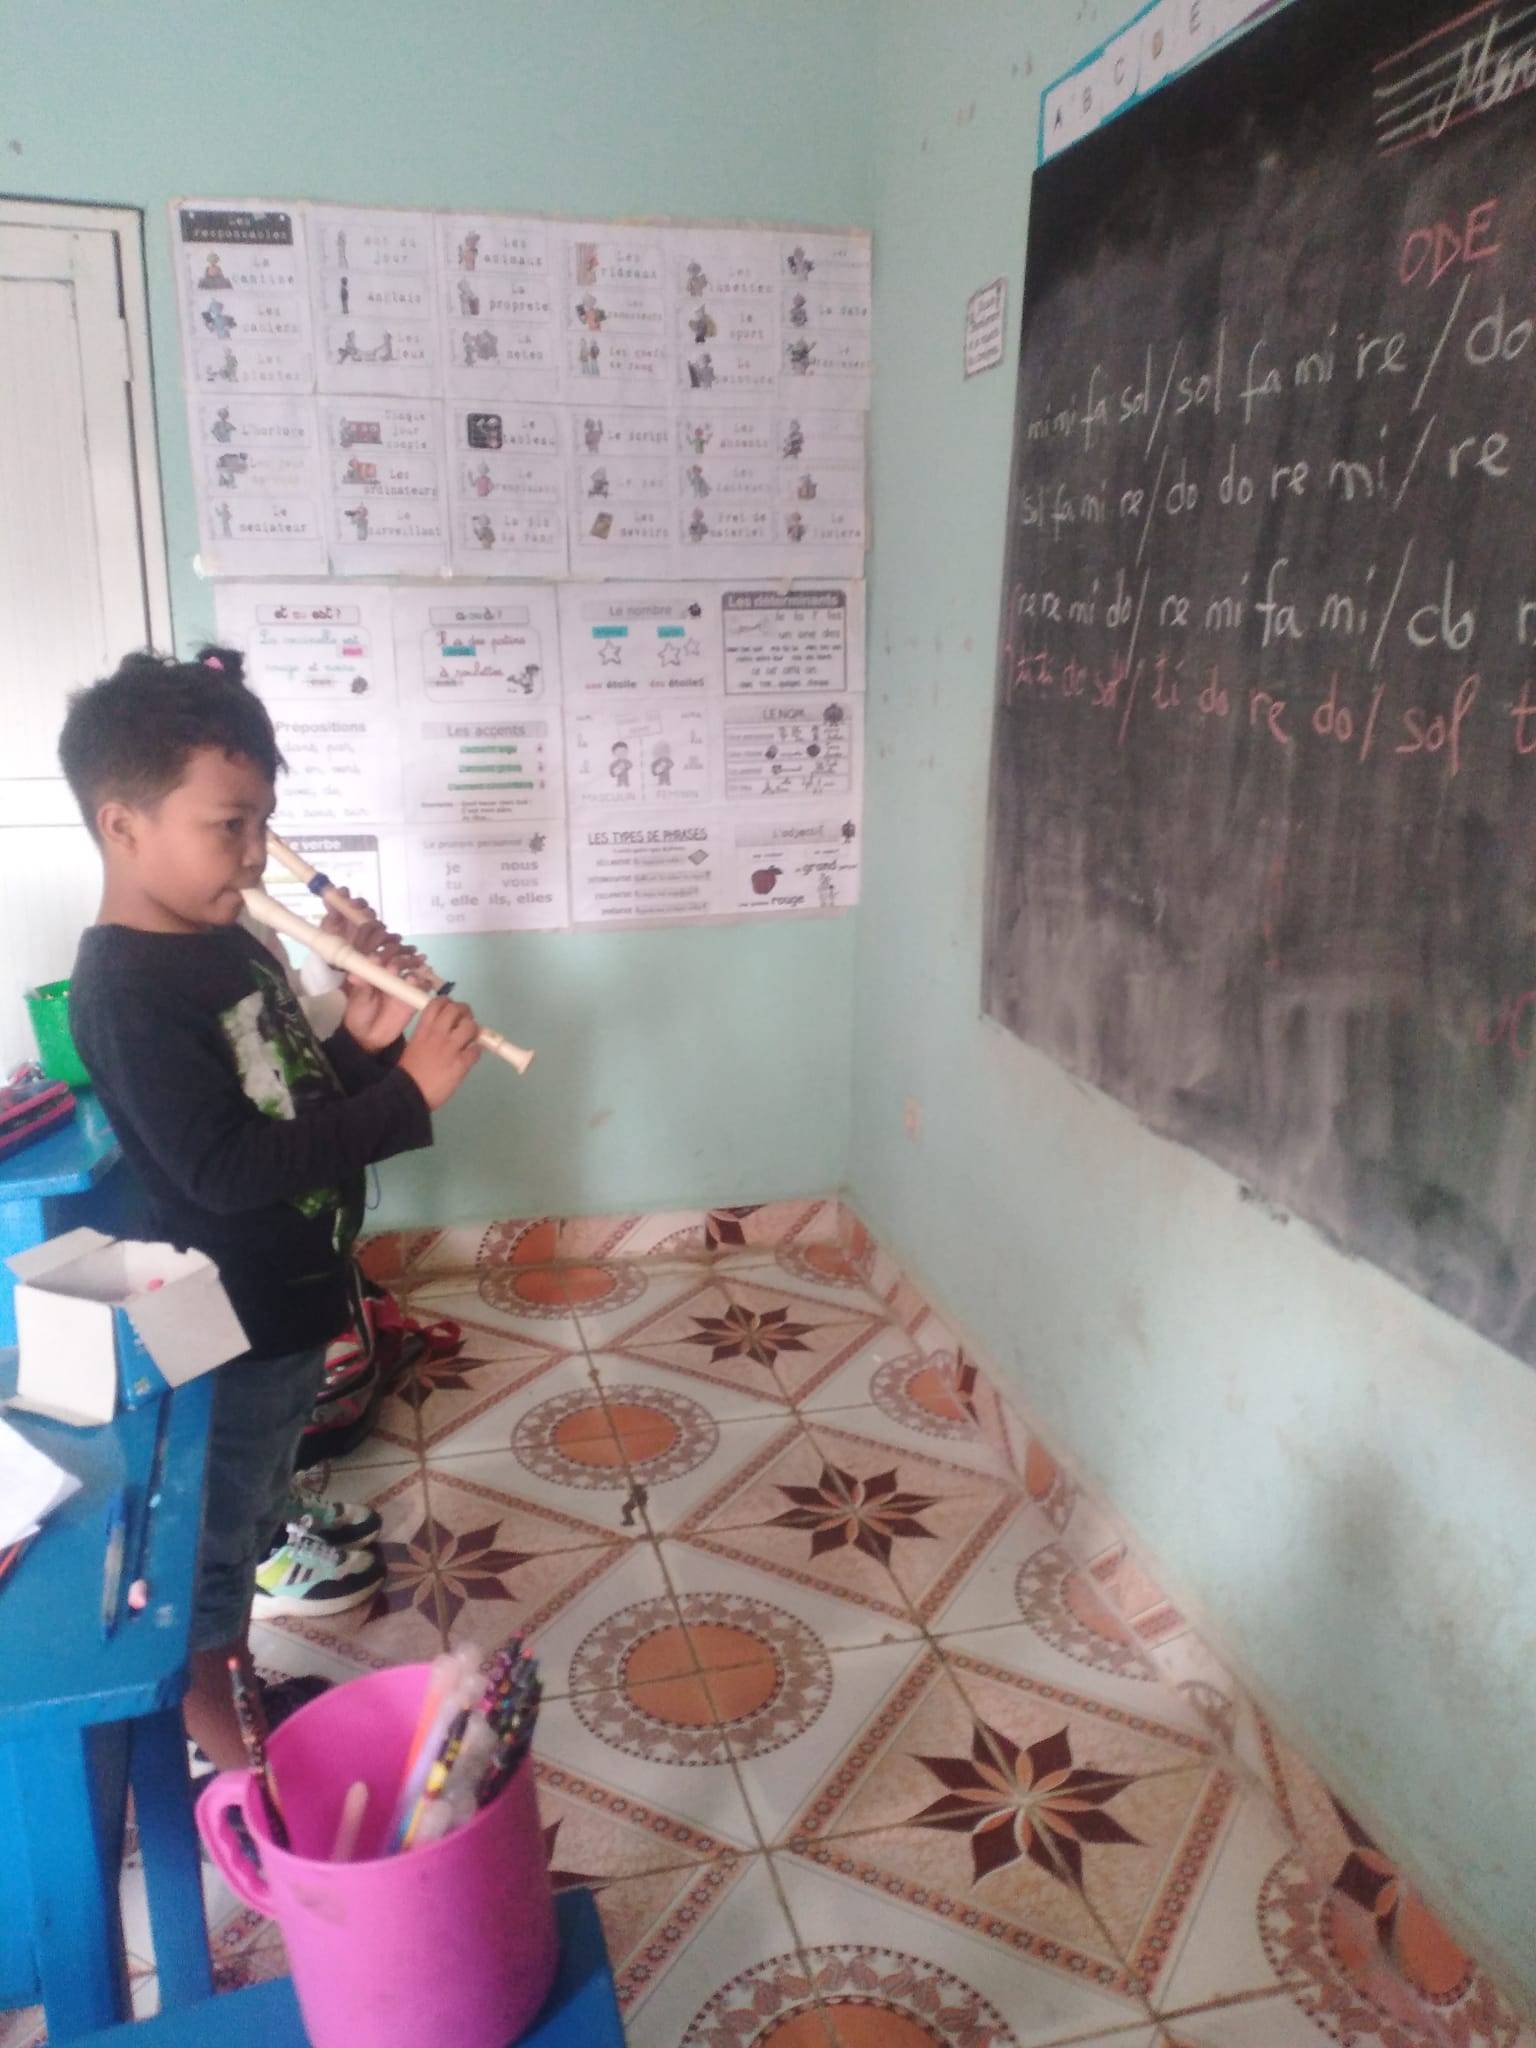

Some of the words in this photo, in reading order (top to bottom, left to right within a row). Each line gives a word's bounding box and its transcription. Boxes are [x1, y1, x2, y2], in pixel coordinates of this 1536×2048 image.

[1402, 197, 1500, 289] ODE
[1239, 337, 1282, 425] fa
[1355, 331, 1407, 382] re
[1464, 293, 1536, 366] do
[1219, 442, 1254, 505] do
[1448, 431, 1511, 480] re
[1255, 558, 1304, 648] fa
[1311, 671, 1355, 743] do
[500, 861, 539, 871] nous
[587, 830, 609, 846] LES
[612, 829, 644, 844] TYPES
[501, 878, 539, 888] vous
[515, 891, 553, 904] elles
